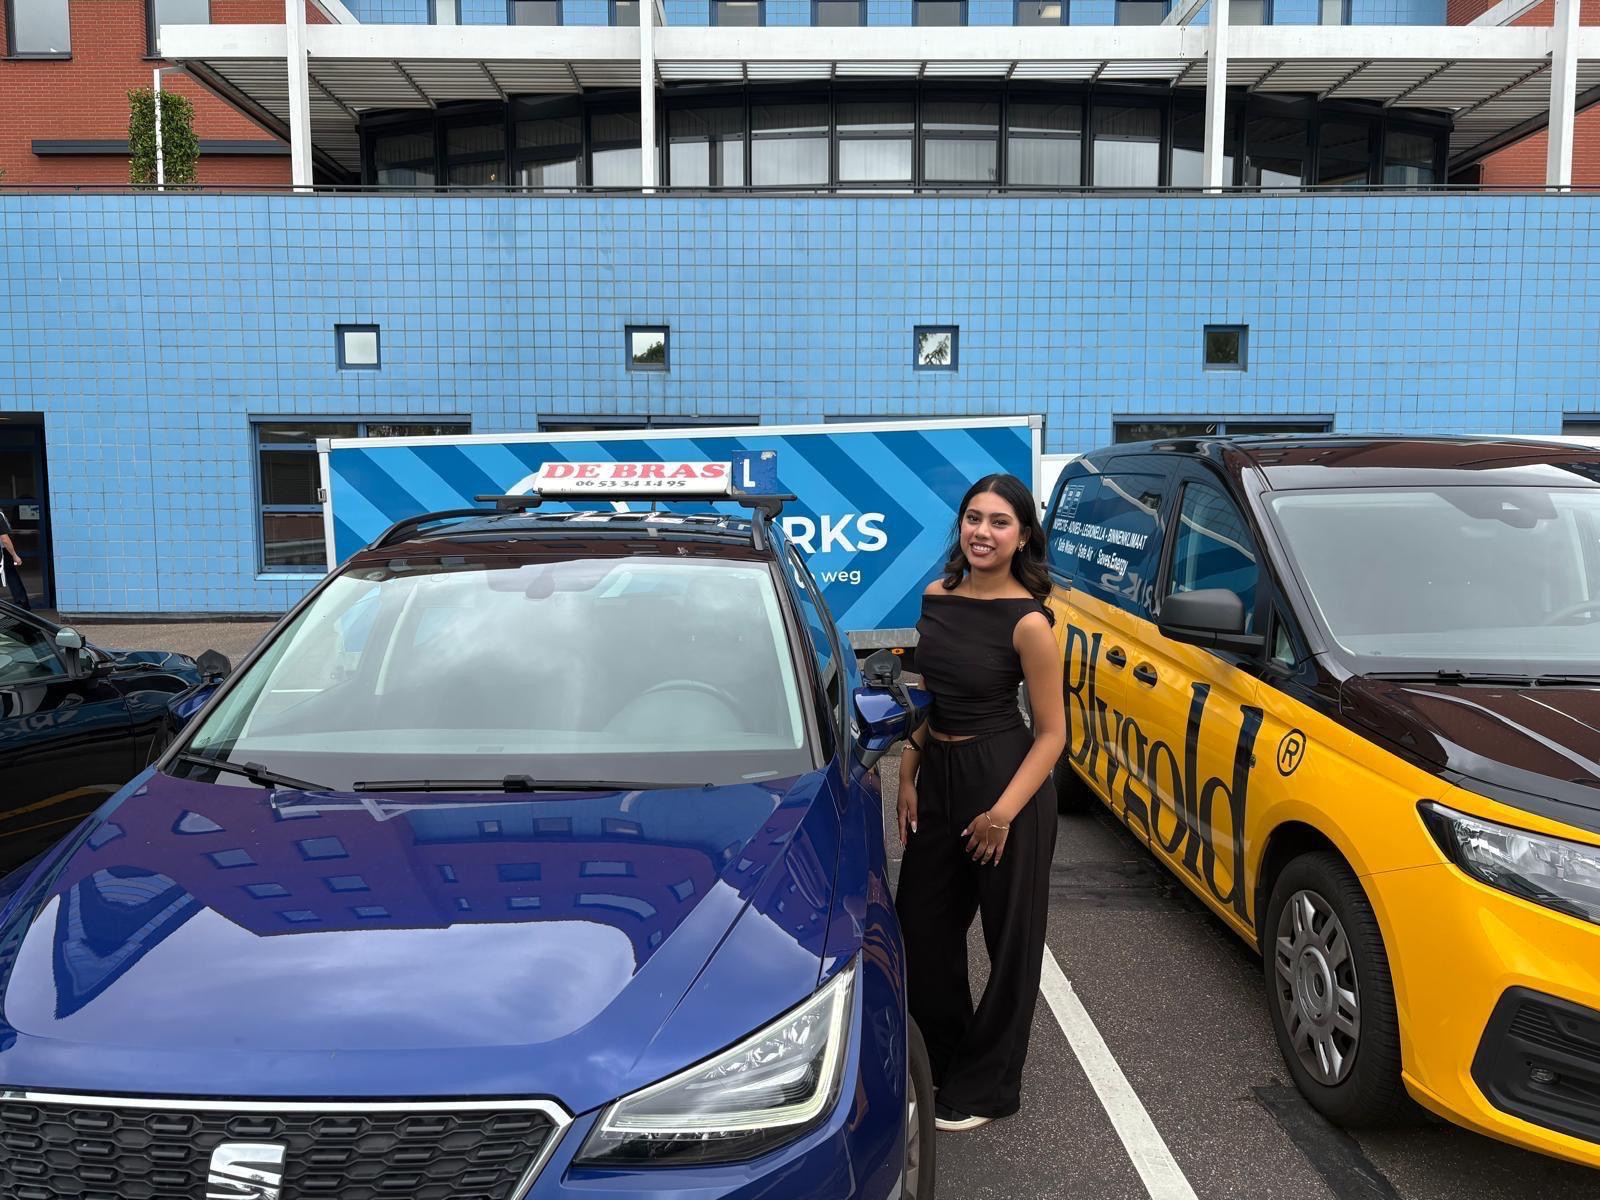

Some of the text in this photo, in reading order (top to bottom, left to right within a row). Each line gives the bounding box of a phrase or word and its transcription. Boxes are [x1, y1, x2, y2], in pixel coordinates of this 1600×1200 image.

[542, 463, 726, 479] DE BRAS
[742, 458, 756, 488] L
[598, 480, 617, 488] 53
[621, 480, 640, 488] 34
[781, 512, 888, 553] RKS
[821, 570, 861, 585] weg
[1063, 623, 1264, 928] Blygold
